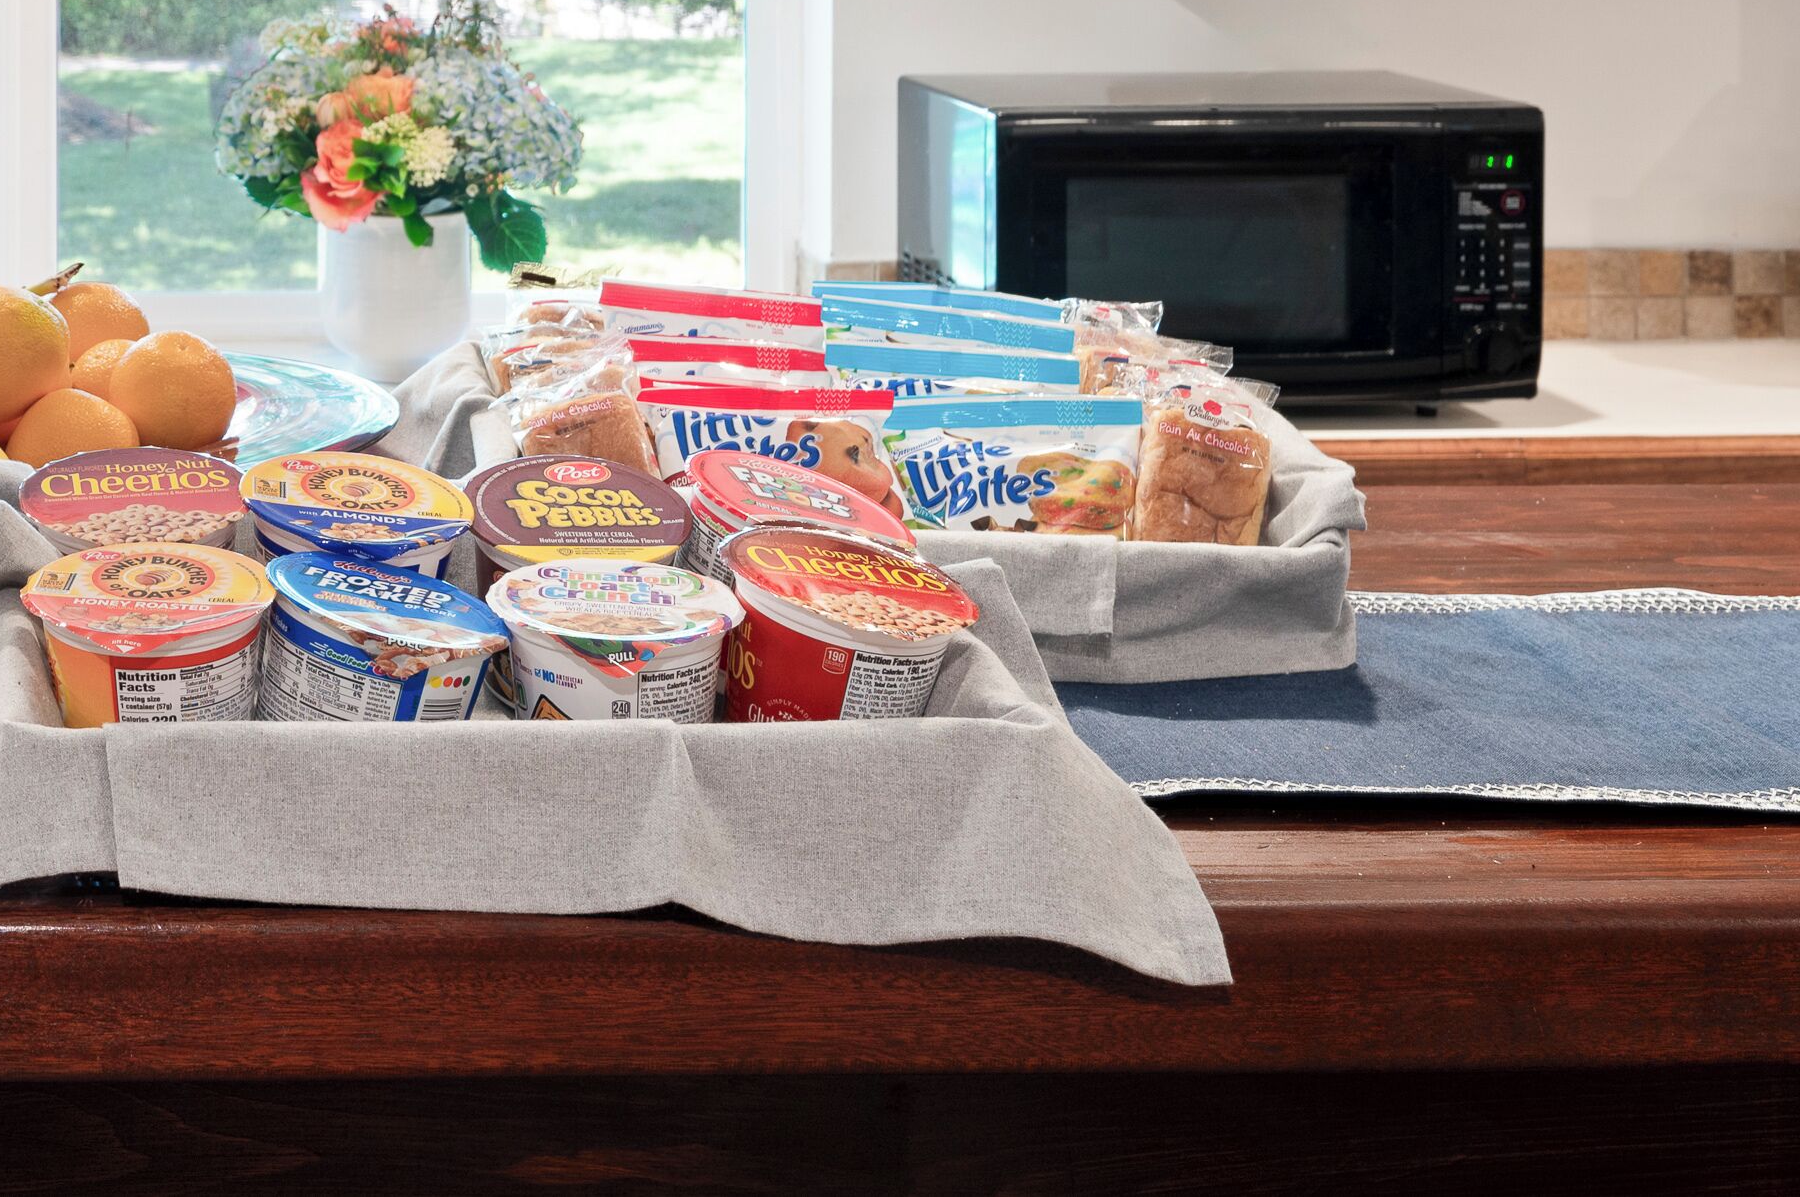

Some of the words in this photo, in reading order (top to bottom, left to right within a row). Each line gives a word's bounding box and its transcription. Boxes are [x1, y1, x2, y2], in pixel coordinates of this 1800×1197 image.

[552, 411, 565, 422] Au
[568, 398, 614, 416] Chocolat
[1160, 422, 1182, 436] Pain
[1186, 428, 1200, 441] Au
[1205, 434, 1250, 455] Chocolat
[105, 462, 168, 474] Honey
[175, 459, 213, 470] Nut
[286, 459, 315, 471] Post
[554, 464, 600, 480] Post
[905, 441, 1014, 509] Little
[40, 468, 230, 498] Cheerios
[309, 468, 344, 491] HONEY
[348, 468, 409, 500] BUNCHES
[729, 466, 844, 503] FROOT
[516, 480, 644, 508] COCOA
[948, 465, 1057, 519] Bites
[340, 499, 400, 512] OATS
[748, 482, 852, 518] LOOPS
[320, 509, 407, 525] ALMONDS
[417, 510, 442, 518] CEREAL
[506, 498, 662, 529] PEBBLES
[84, 552, 118, 560] Post
[803, 546, 869, 564] Honey
[101, 556, 146, 580] HONEY
[152, 556, 208, 586] BUNCHES
[333, 560, 413, 583] Kellogg's
[538, 566, 680, 586] Cinnamon
[746, 546, 947, 592] Cheerios
[127, 585, 192, 598] OATS
[304, 566, 452, 603] FROSTED
[566, 580, 651, 592] Toast
[316, 577, 443, 609] FLAKES
[538, 586, 676, 606] Crunch
[73, 598, 132, 608] HONEY
[134, 602, 212, 612] ROASTED
[423, 606, 456, 618] CORN
[326, 649, 348, 662] Good
[348, 655, 368, 670] Food
[608, 652, 635, 663] PULL
[827, 650, 845, 662] 190
[856, 653, 890, 665] Nutrition
[892, 658, 912, 666] Facts
[118, 672, 176, 682] Nutrition
[306, 665, 317, 674] Total
[542, 669, 555, 683] NO
[642, 672, 674, 682] Nutrition
[676, 668, 694, 678] Facts
[556, 674, 583, 684] ARTIFICIAL
[556, 681, 577, 689] FLAVORS
[667, 681, 688, 690] Calories
[119, 682, 156, 692] Facts
[120, 695, 145, 703] Serving
[613, 702, 628, 714] 240
[767, 698, 792, 706] SIMPLY
[794, 704, 811, 720] MAD
